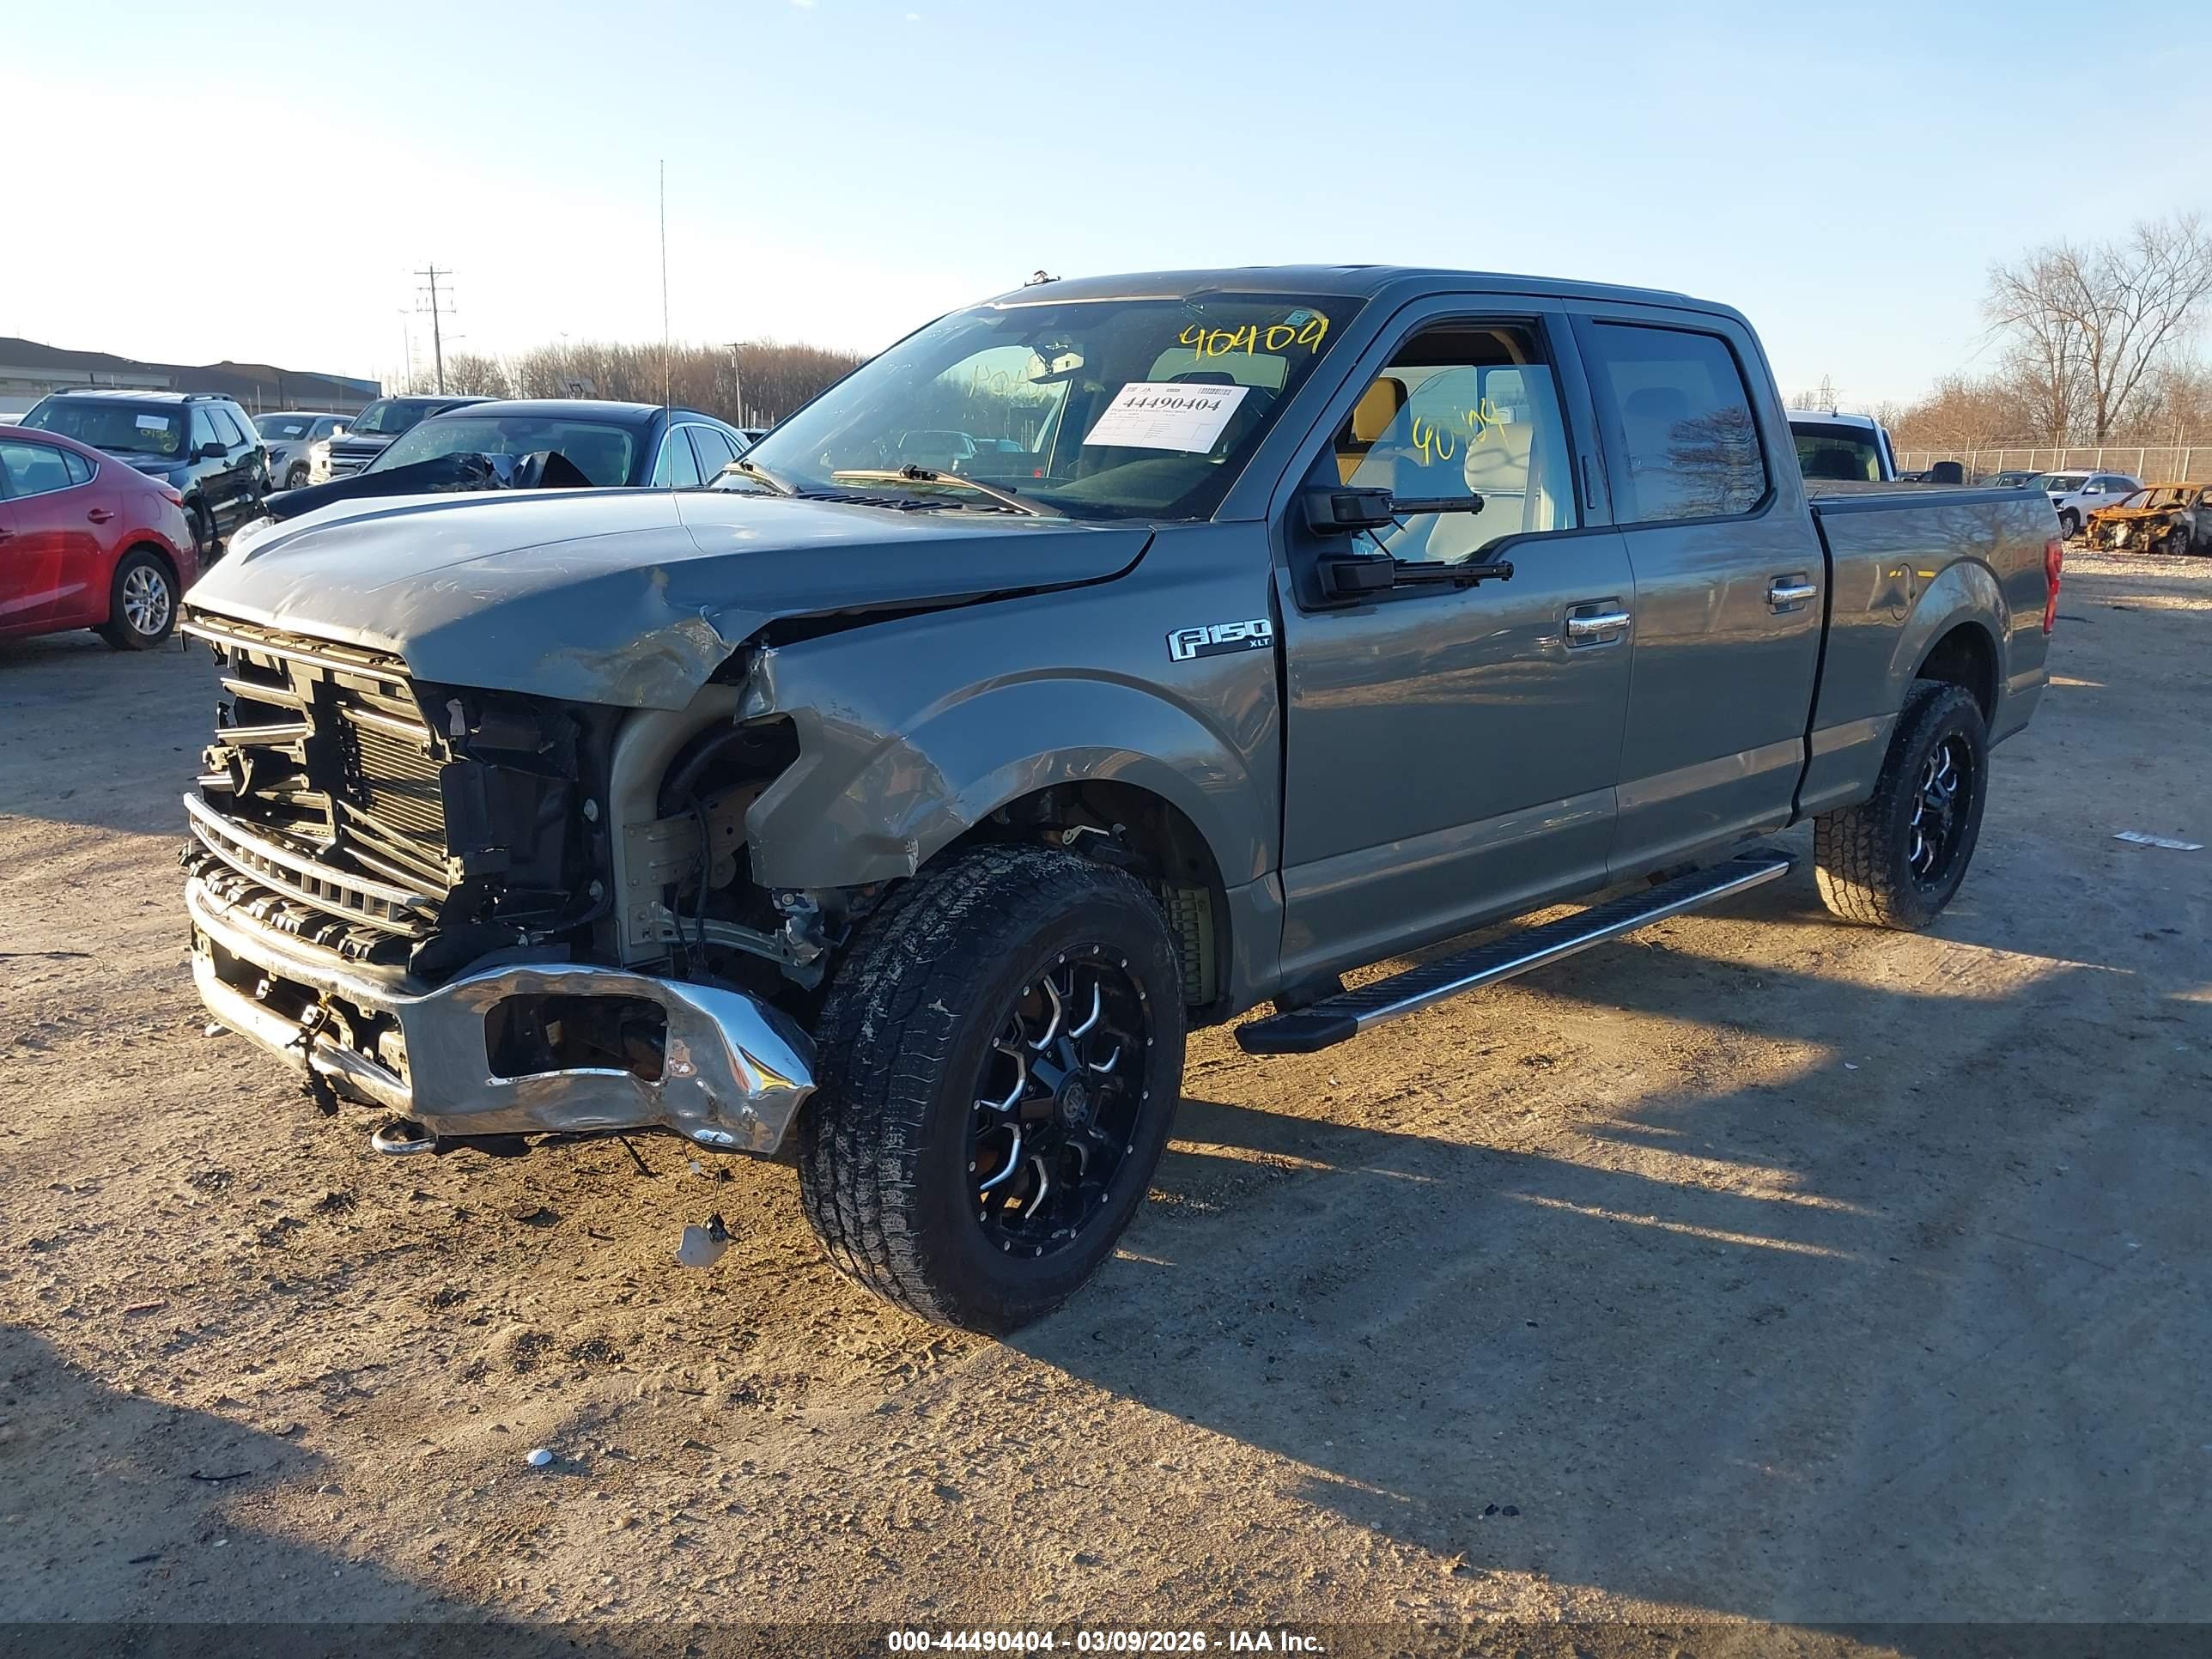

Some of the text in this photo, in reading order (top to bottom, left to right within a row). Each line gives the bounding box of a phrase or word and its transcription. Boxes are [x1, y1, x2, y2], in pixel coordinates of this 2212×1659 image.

[1179, 319, 1330, 362] 40404
[1122, 396, 1223, 411] 44490404
[1249, 638, 1270, 647] XLT
